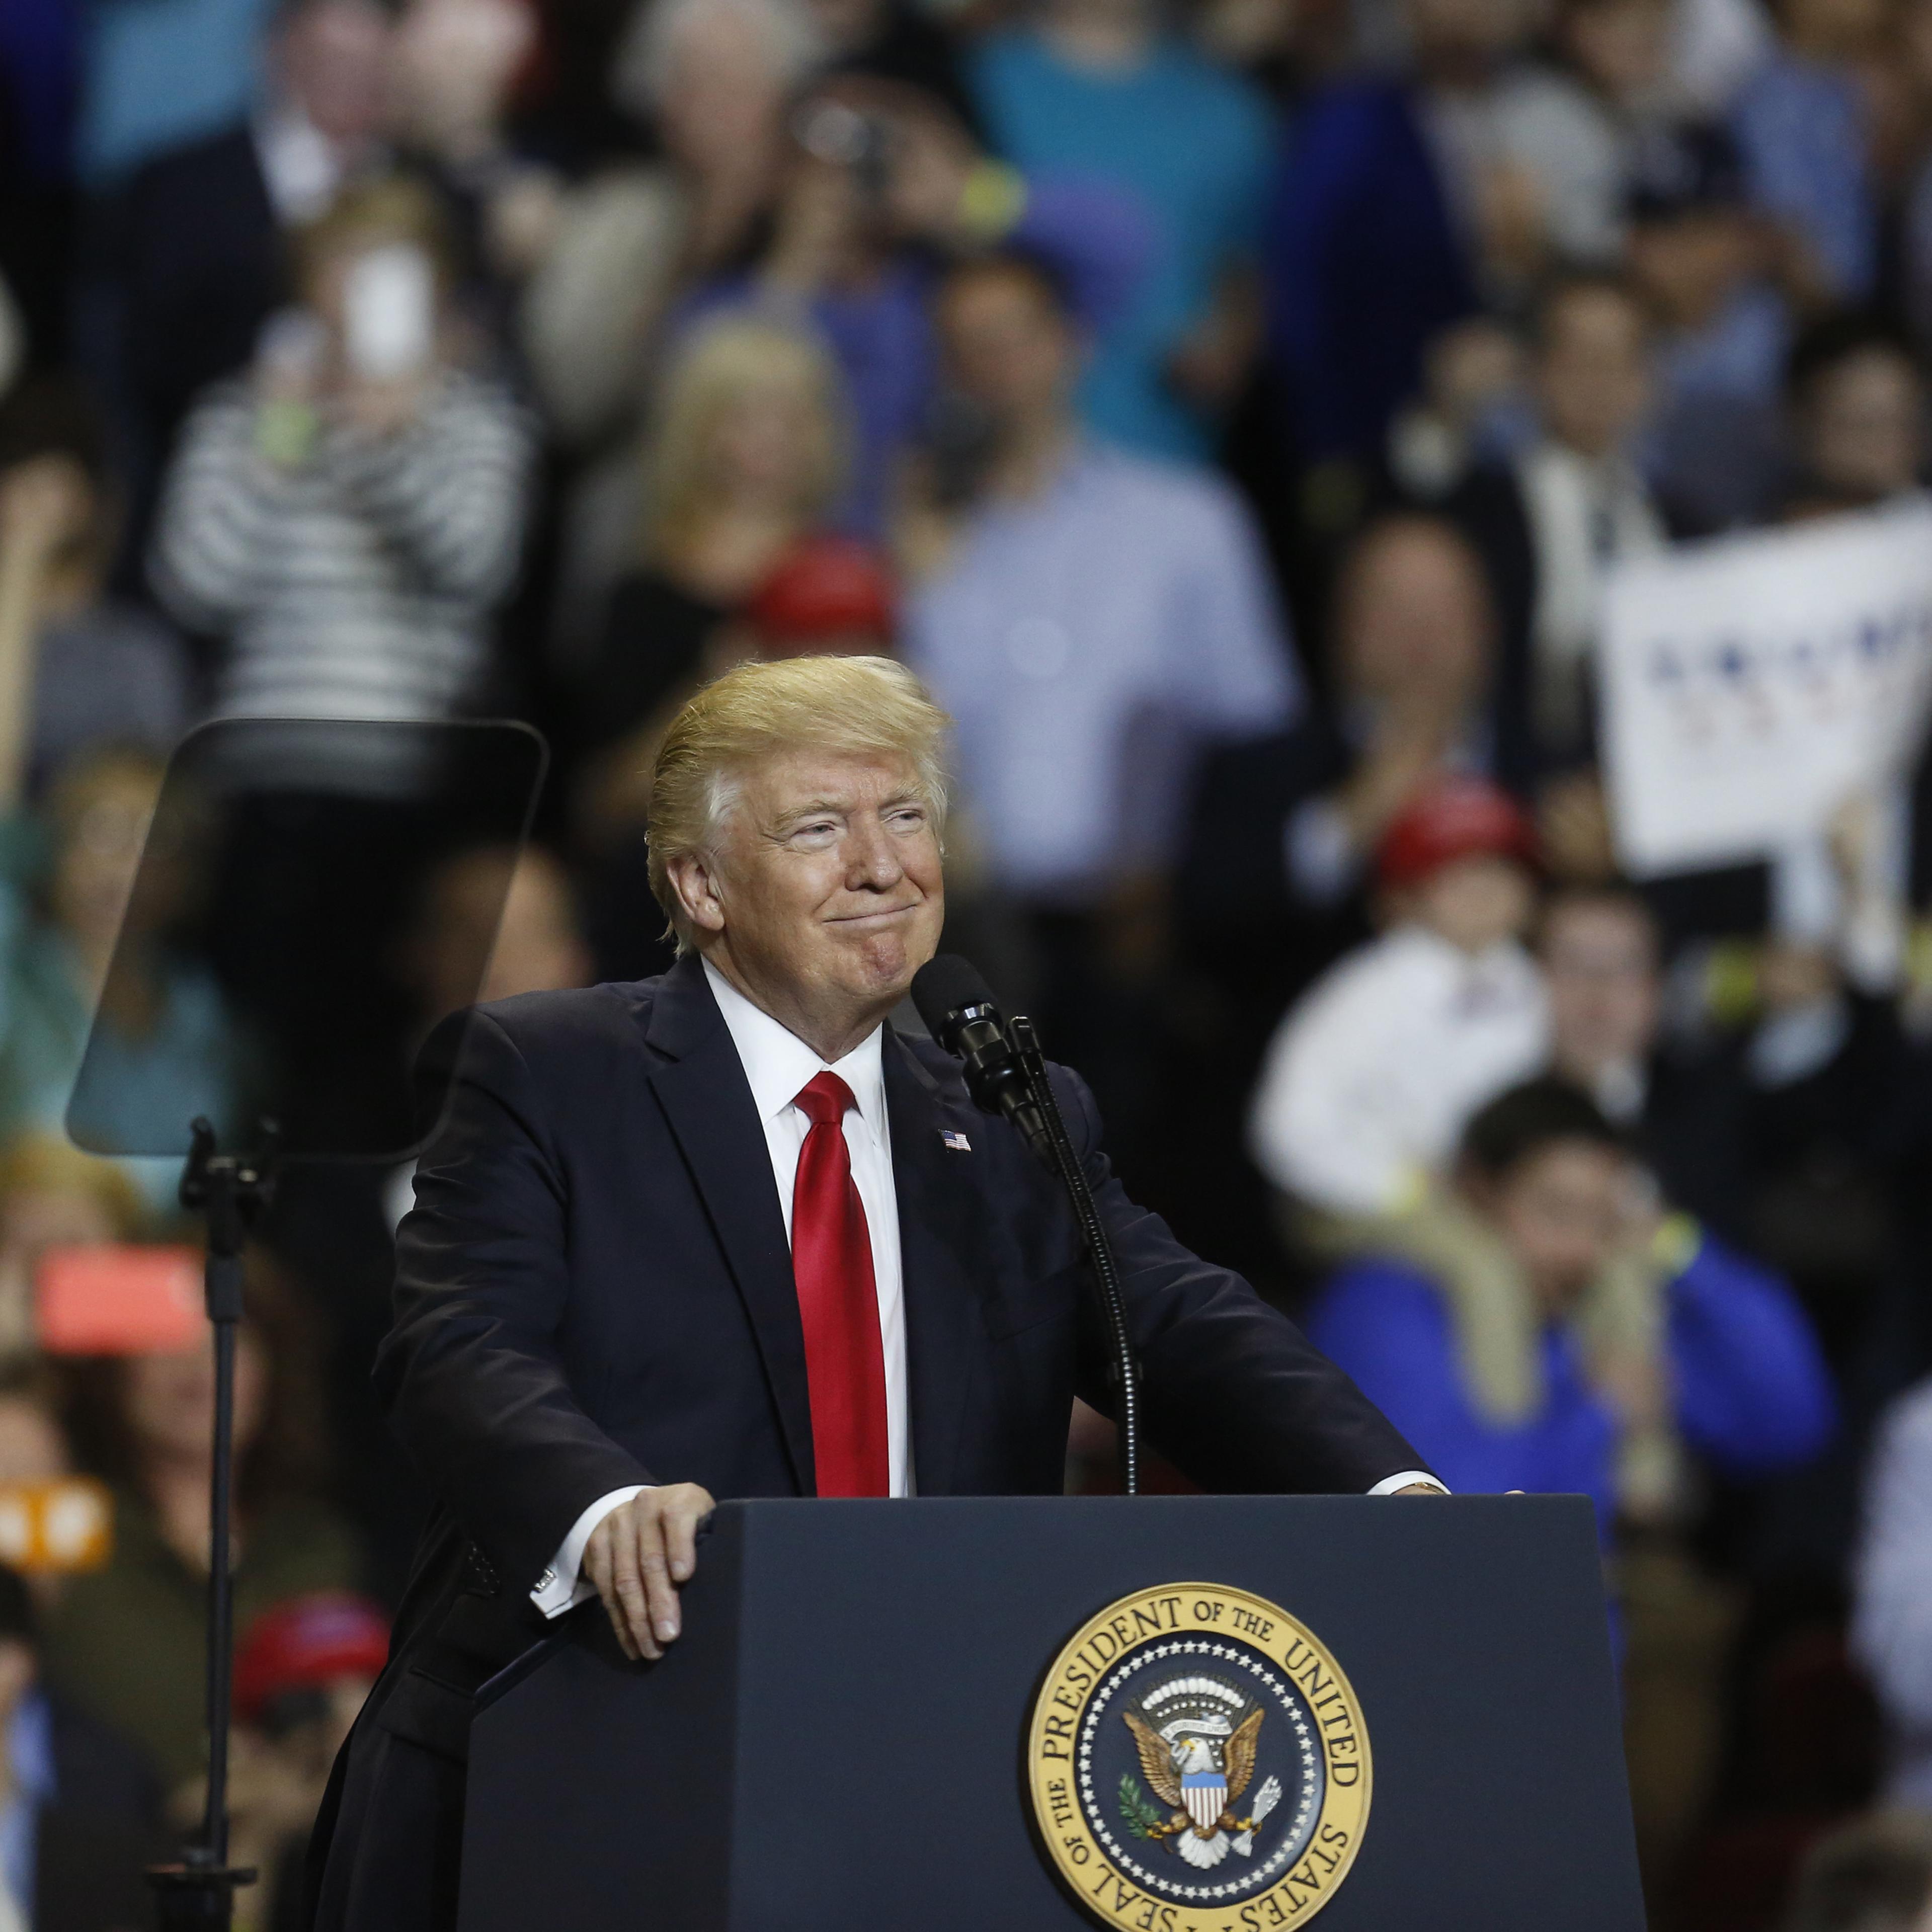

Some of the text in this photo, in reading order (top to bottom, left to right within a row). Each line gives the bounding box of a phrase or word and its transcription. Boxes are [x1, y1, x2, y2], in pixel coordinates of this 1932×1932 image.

[1042, 1597, 1358, 1932] SEAL OF THE PRESIDENT OF THE UNITED STATES
